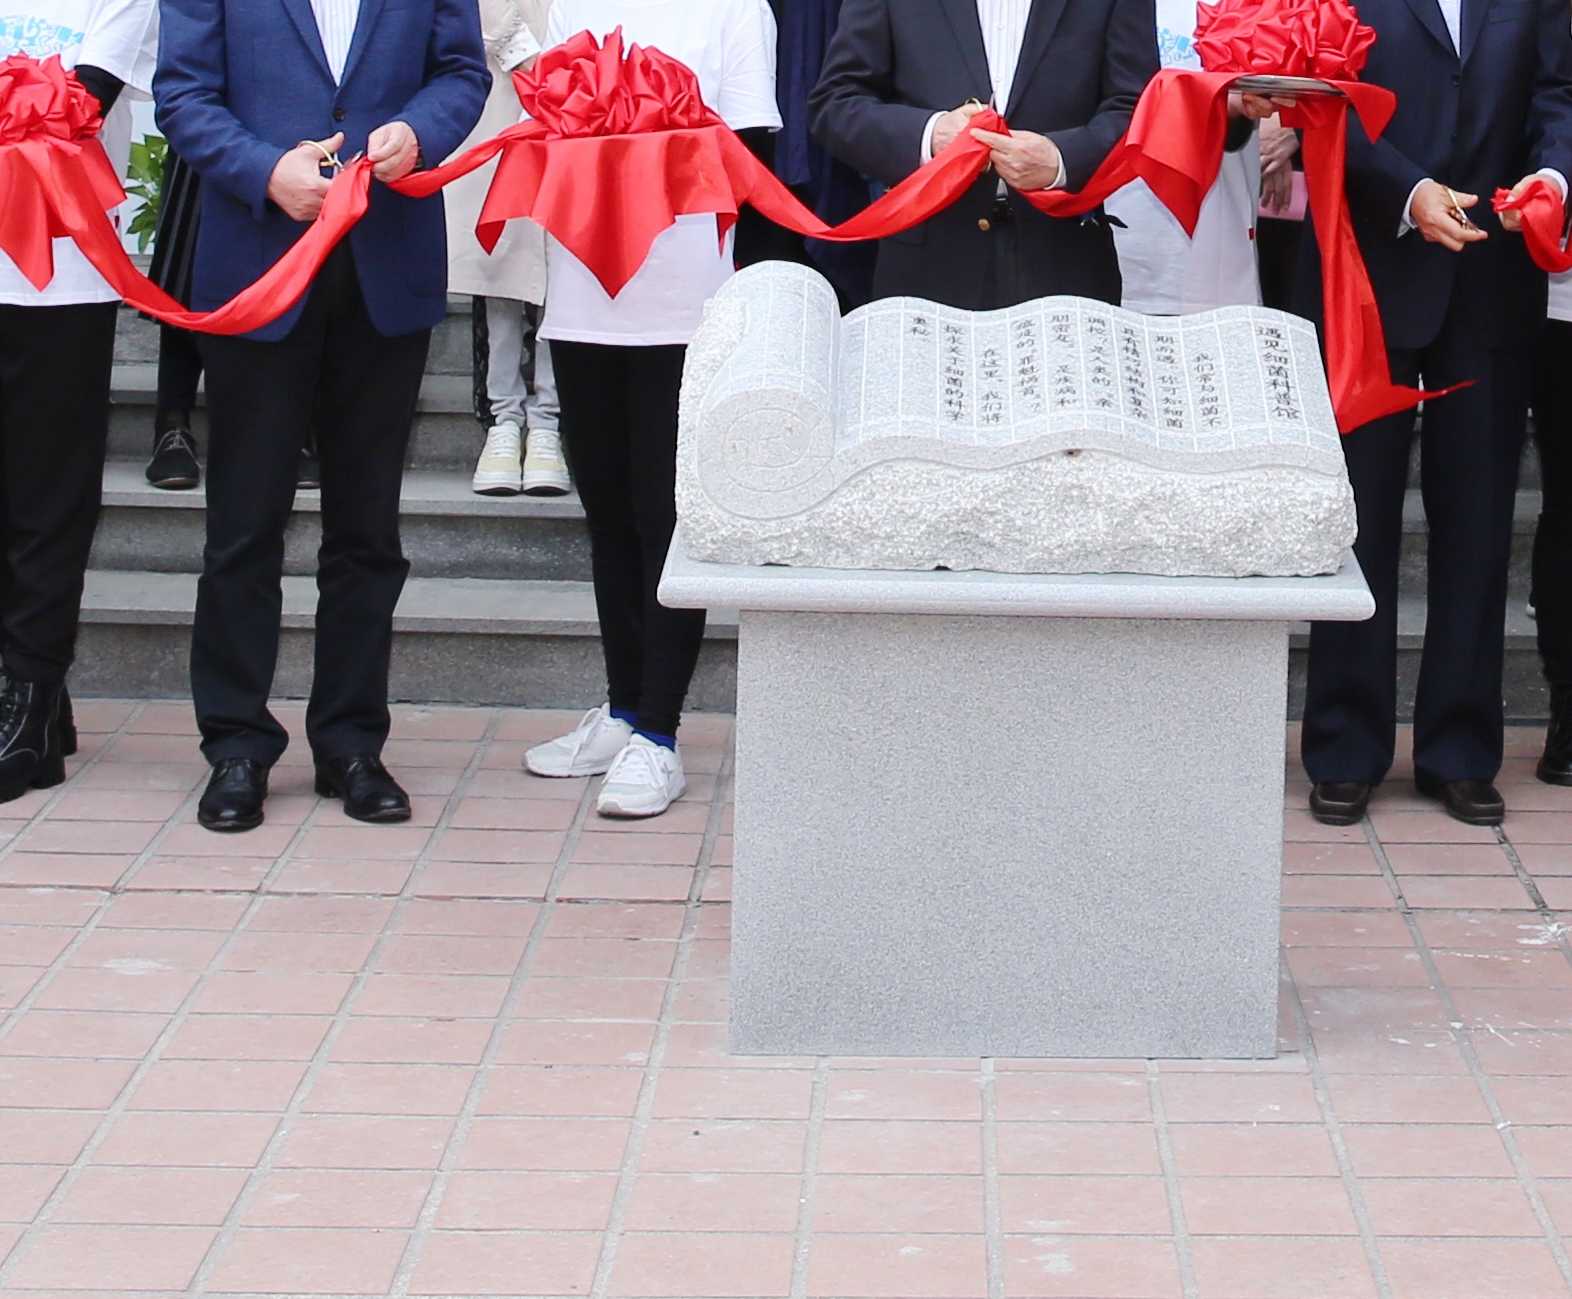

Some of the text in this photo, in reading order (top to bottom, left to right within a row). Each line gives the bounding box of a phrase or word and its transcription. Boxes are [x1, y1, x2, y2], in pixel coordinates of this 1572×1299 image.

[1193, 352, 1222, 428] 我们常与细菌不
[1256, 325, 1299, 420] 遇见细菌科普馆
